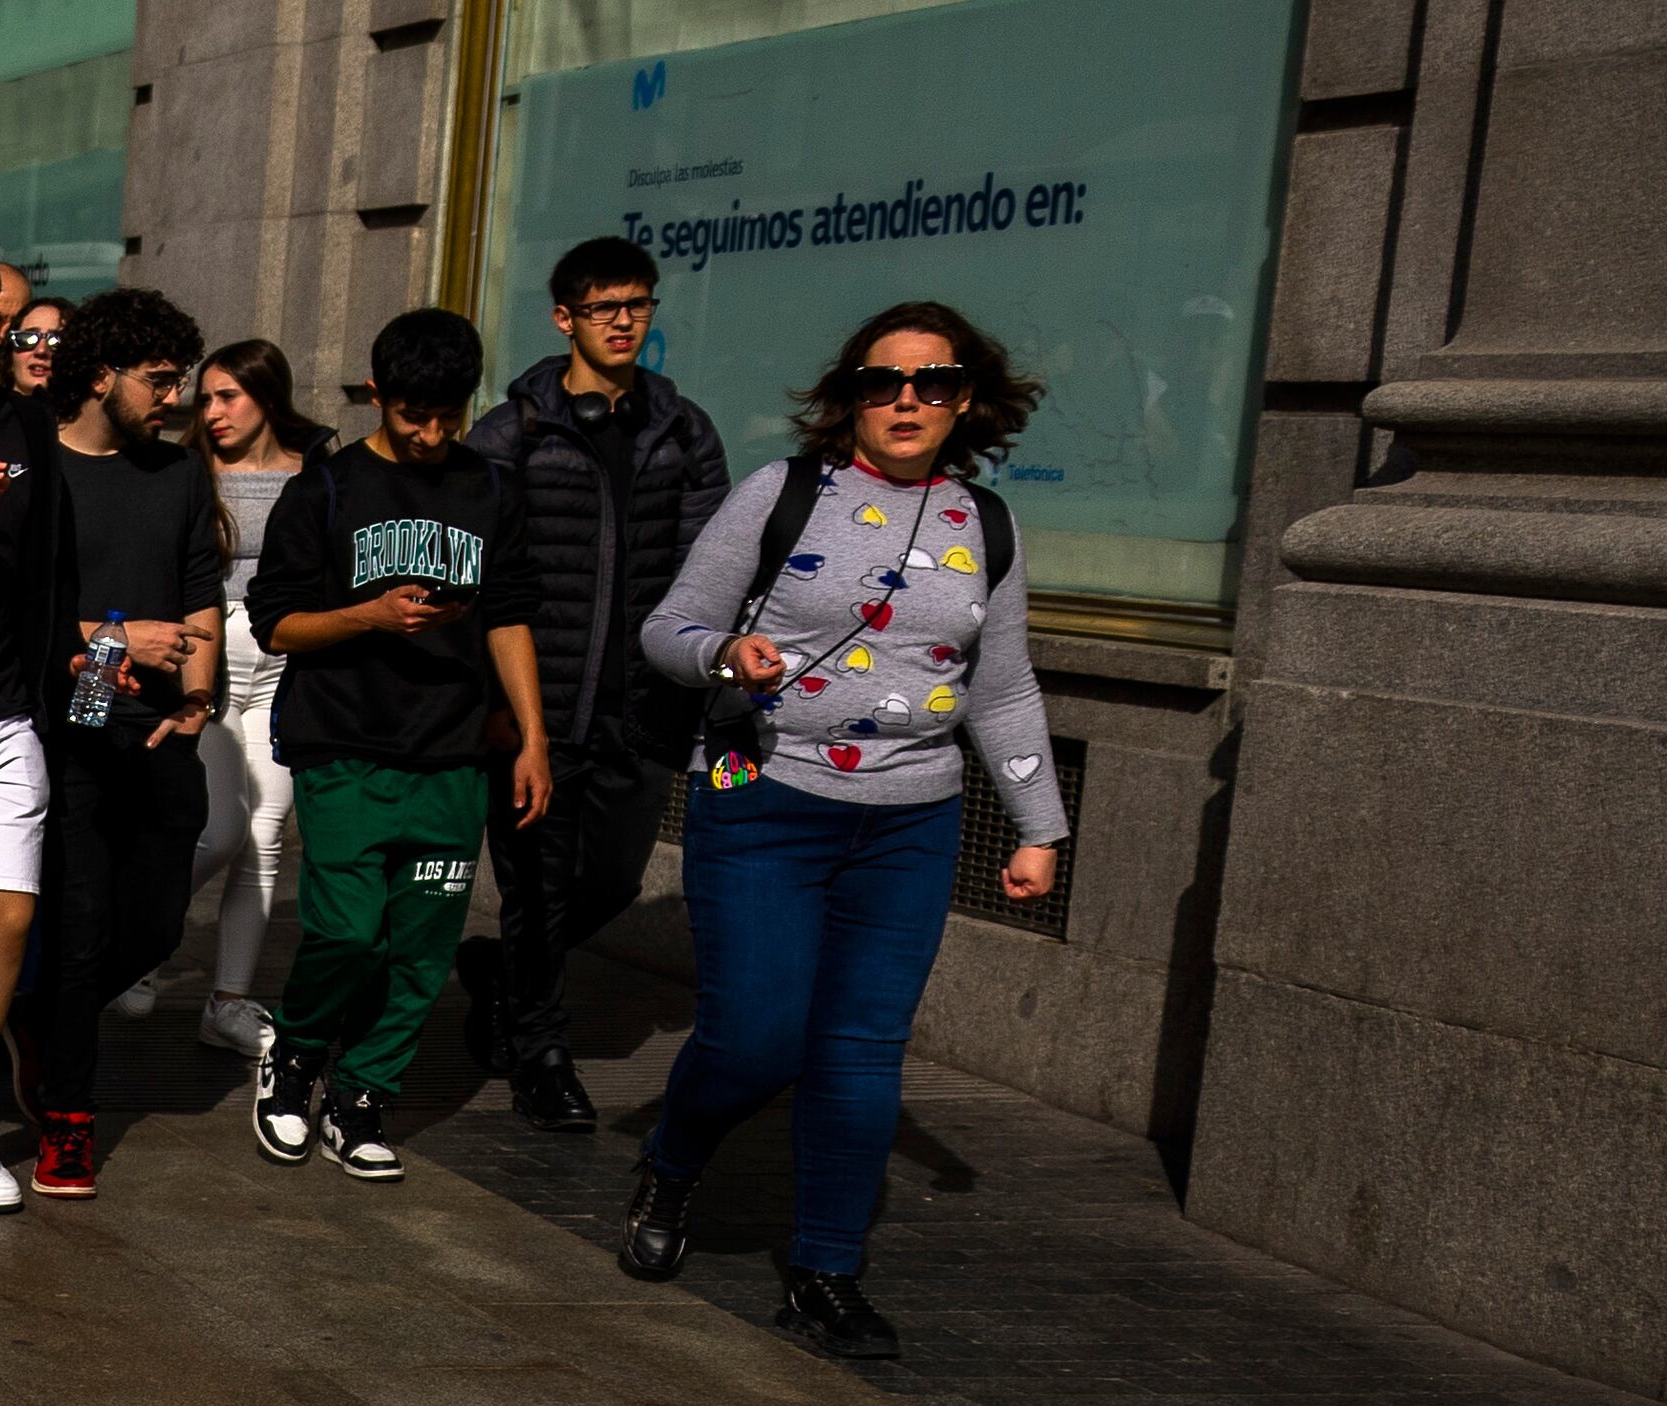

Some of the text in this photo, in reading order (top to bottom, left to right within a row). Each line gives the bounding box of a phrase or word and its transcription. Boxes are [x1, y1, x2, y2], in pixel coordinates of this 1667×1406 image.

[628, 166, 672, 188] Disculpa
[674, 162, 689, 181] las
[660, 200, 803, 272] seguimos
[811, 172, 1016, 246] atendiendo
[1025, 180, 1088, 227] en:
[1008, 464, 1065, 482] Telefónica
[352, 518, 484, 589] BROOKLYN
[414, 861, 444, 881] LOS
